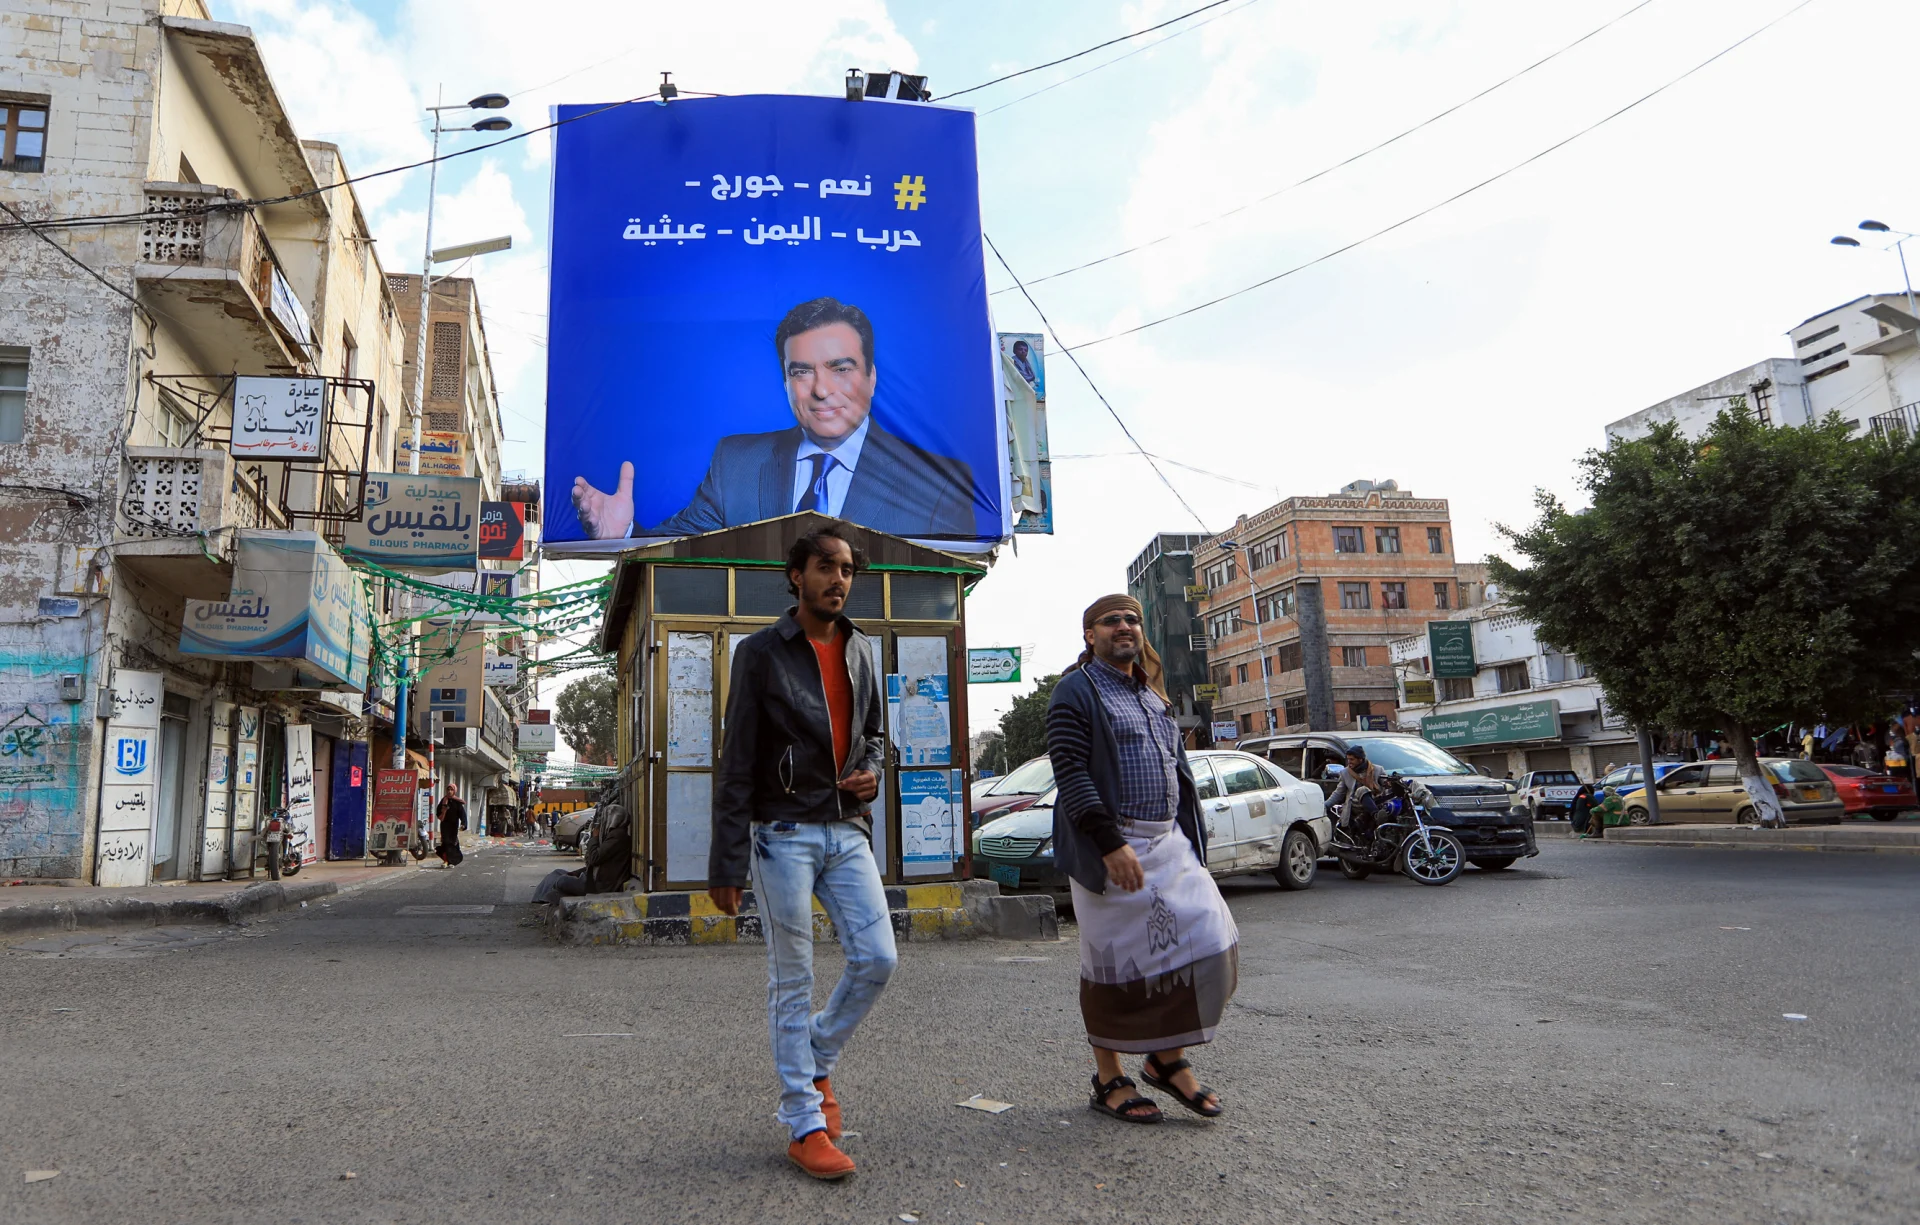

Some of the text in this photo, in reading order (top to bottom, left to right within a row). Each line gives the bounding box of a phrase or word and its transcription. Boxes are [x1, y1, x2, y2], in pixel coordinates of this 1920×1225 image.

[711, 174, 784, 200] جورج
[819, 174, 872, 198] نعم
[623, 214, 706, 246] عبثية
[743, 215, 821, 245] اليمن
[856, 226, 921, 252] حرب
[289, 380, 319, 400] عيادة
[284, 399, 318, 417] ومعمل
[244, 417, 313, 436] الاسنان
[405, 484, 461, 502] صيدلية
[368, 502, 471, 540] بلقيس
[369, 539, 469, 551] BILQUIS PHARMACY
[194, 597, 269, 624] بلقيس
[380, 772, 412, 784] باريس
[115, 791, 146, 811] بلقيس
[378, 786, 411, 796] للعطور
